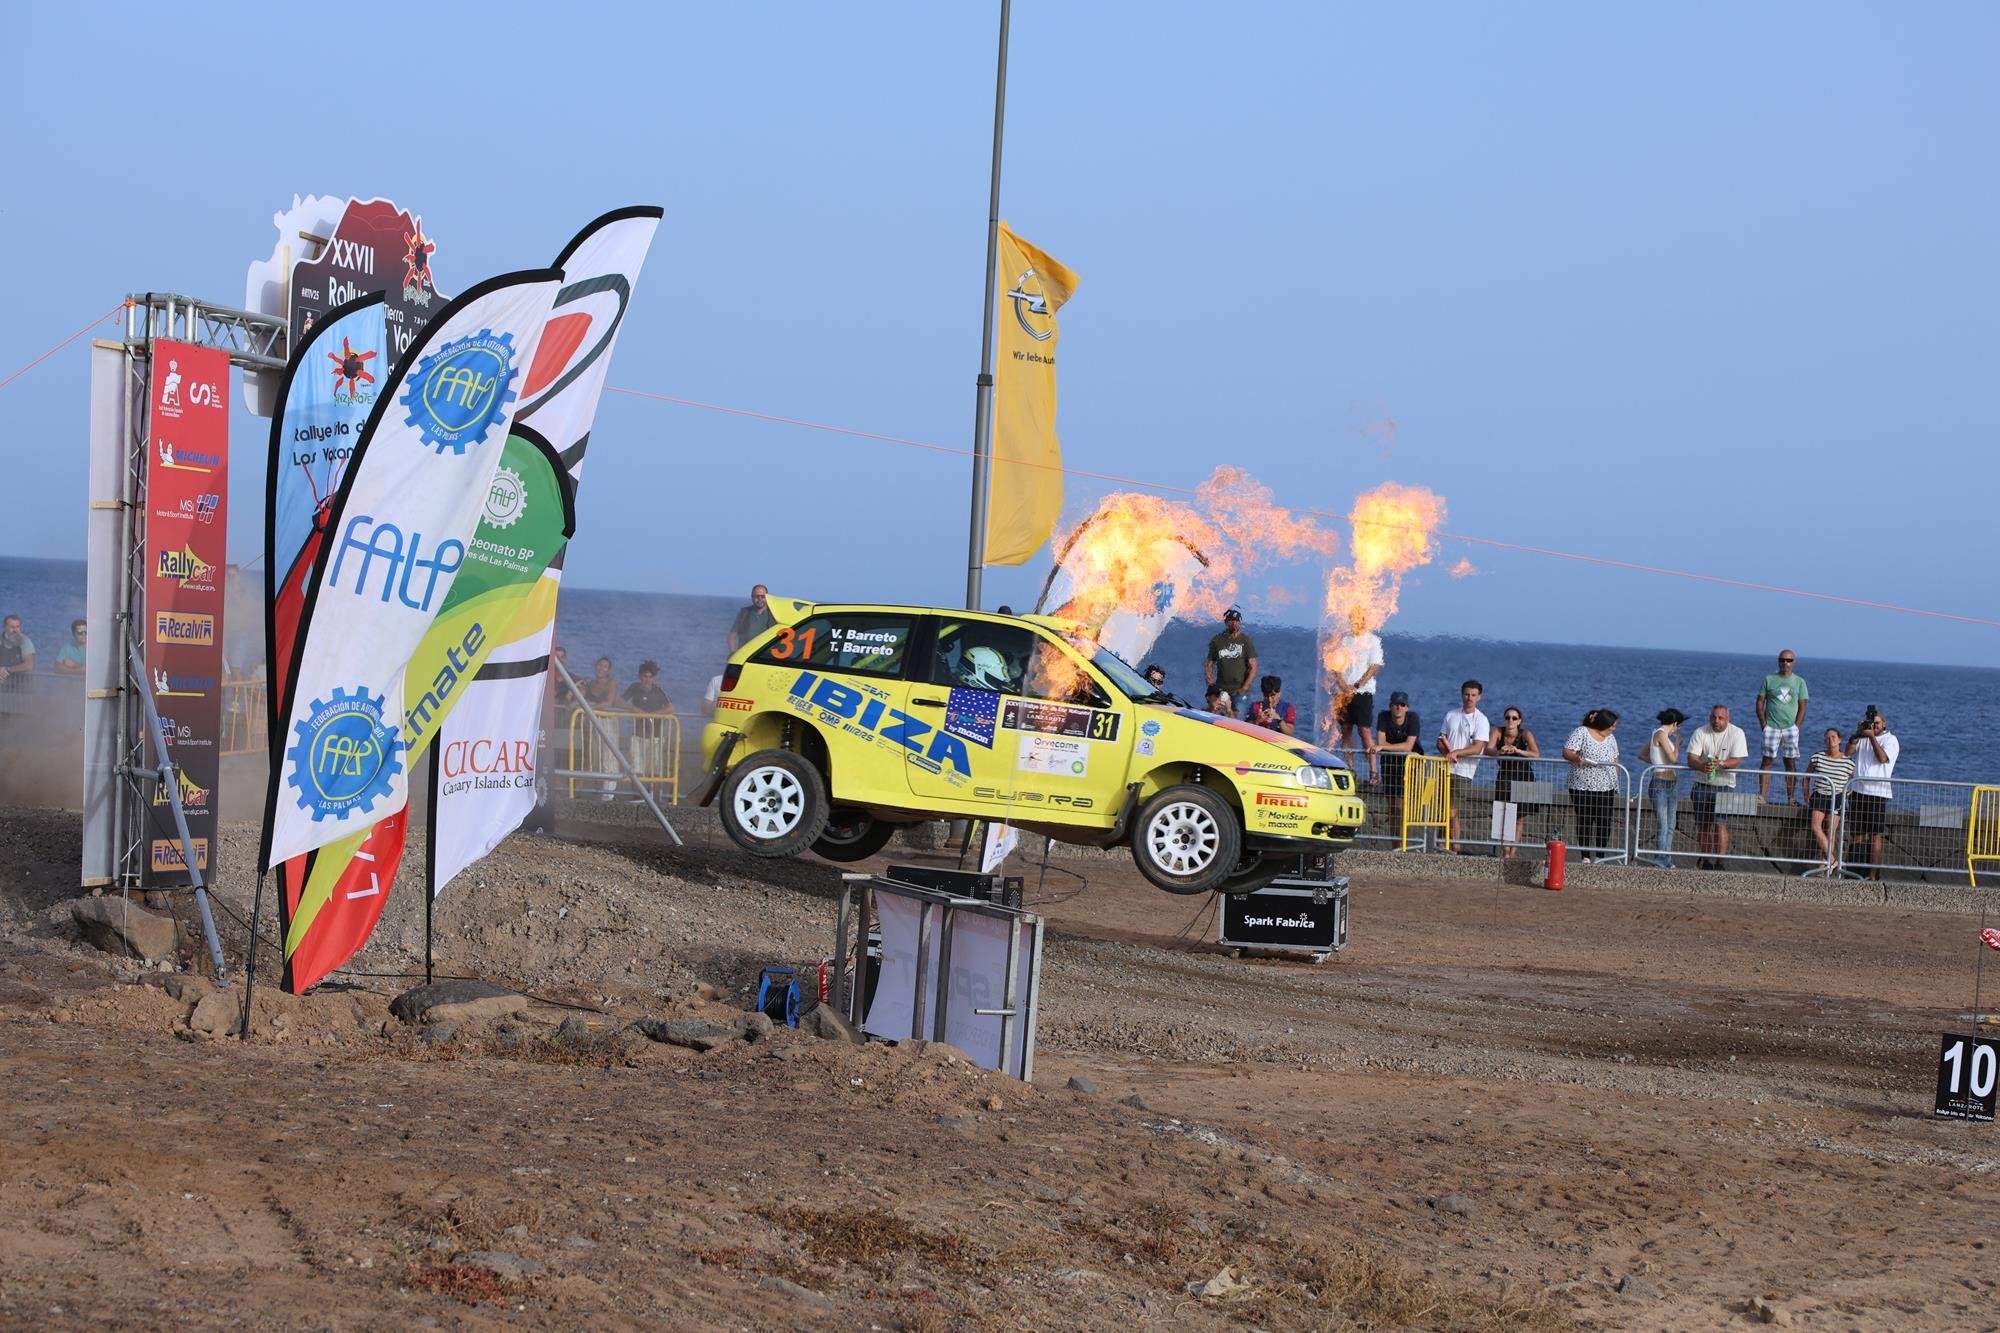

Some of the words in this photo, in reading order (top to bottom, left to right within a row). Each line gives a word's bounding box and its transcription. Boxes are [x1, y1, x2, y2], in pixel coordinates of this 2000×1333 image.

[331, 237, 374, 275] XXVII
[329, 276, 368, 307] Rall
[1013, 351, 1024, 361] Wir
[517, 547, 534, 561] BP
[478, 553, 488, 561] de
[489, 555, 502, 567] Las
[503, 559, 529, 573] Palmas
[167, 618, 203, 639] Recalvi
[832, 628, 843, 639] V.
[846, 629, 897, 643] Barreto
[771, 627, 817, 660] 31
[830, 641, 839, 652] T.
[843, 642, 894, 656] Barreto
[351, 701, 360, 711] DE
[789, 671, 972, 778] IBIZA
[1093, 712, 1114, 739] 31
[957, 726, 988, 744] maxon
[443, 739, 534, 779] CICAR
[1253, 762, 1292, 771] REPSOL
[473, 775, 511, 790] Islands
[515, 775, 534, 788] Car
[1256, 792, 1309, 808] PIRELLI
[1268, 811, 1308, 821] MoviStar
[1268, 821, 1298, 829] maxon
[1244, 915, 1274, 927] Spark
[1276, 913, 1315, 929] Fabrica
[1944, 1040, 1997, 1098] 10
